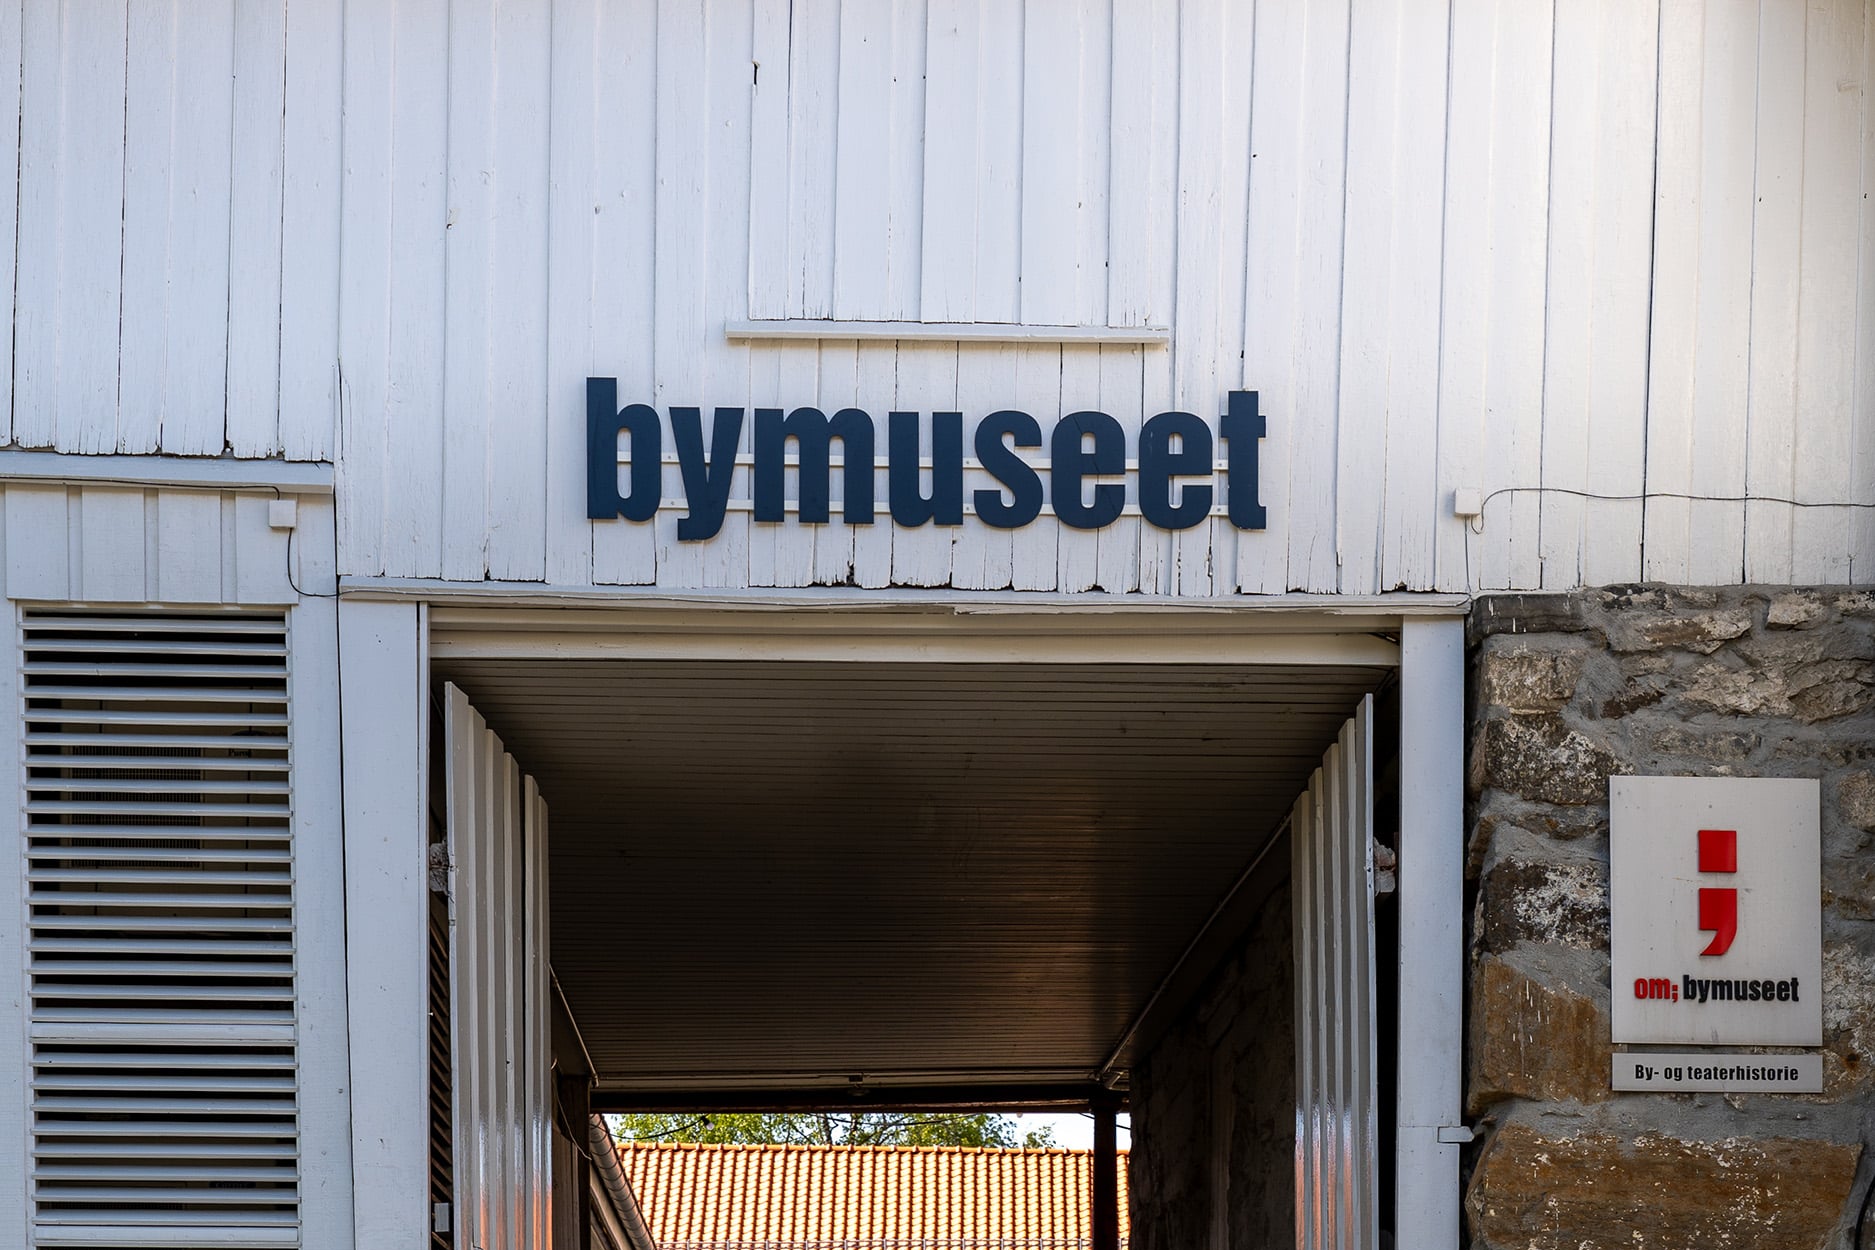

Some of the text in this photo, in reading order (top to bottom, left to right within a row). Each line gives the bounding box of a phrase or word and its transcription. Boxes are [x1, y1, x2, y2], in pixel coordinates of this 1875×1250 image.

[586, 376, 1266, 541] bymuseet
[1634, 975, 1800, 1003] om; bymuseet
[1635, 1065, 1799, 1082] By- og teaterhistorie
